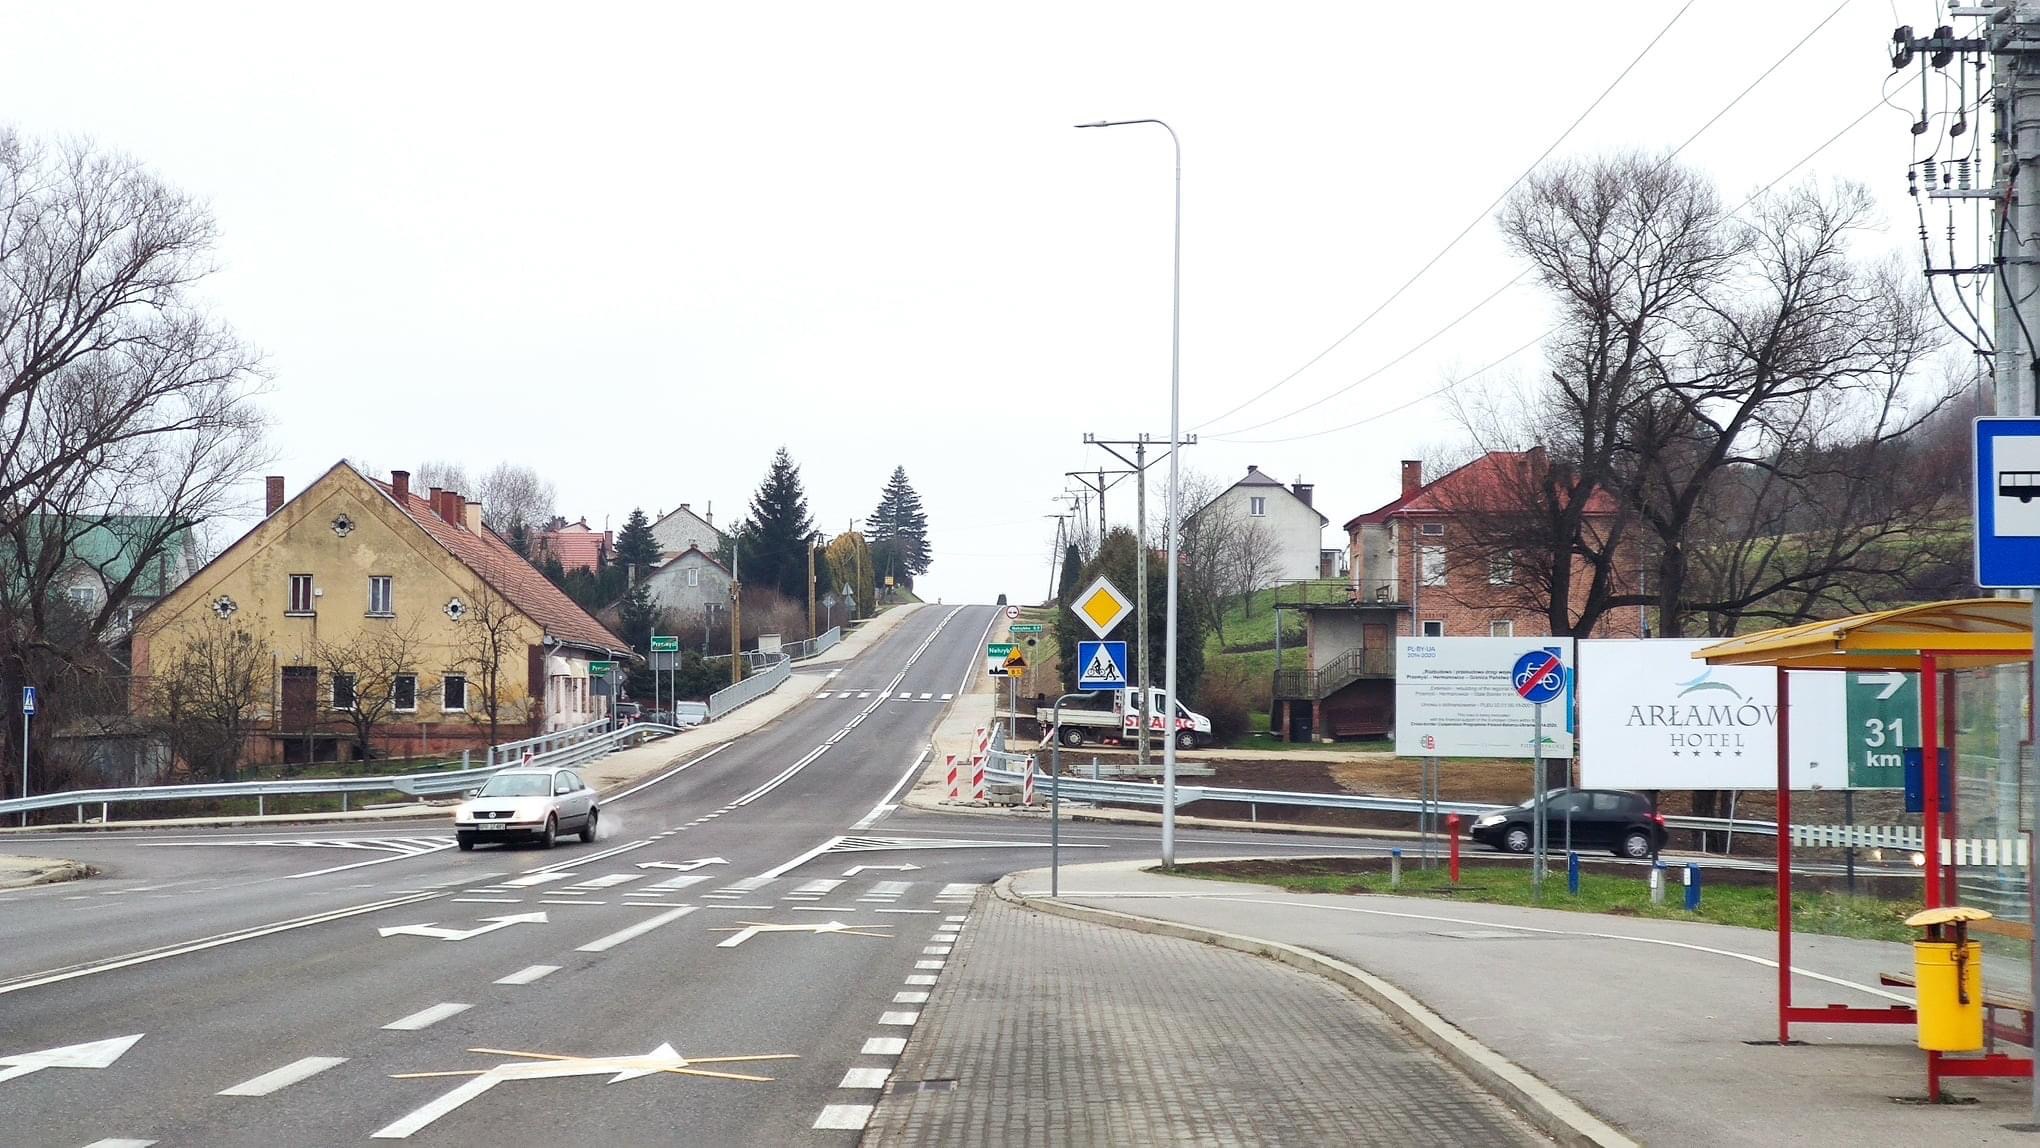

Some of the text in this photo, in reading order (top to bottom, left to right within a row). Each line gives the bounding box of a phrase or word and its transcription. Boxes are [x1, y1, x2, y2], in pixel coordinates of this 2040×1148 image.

[1670, 733, 1745, 747] HOTEL
[1865, 718, 1904, 747] 31
[1867, 750, 1903, 767] km
